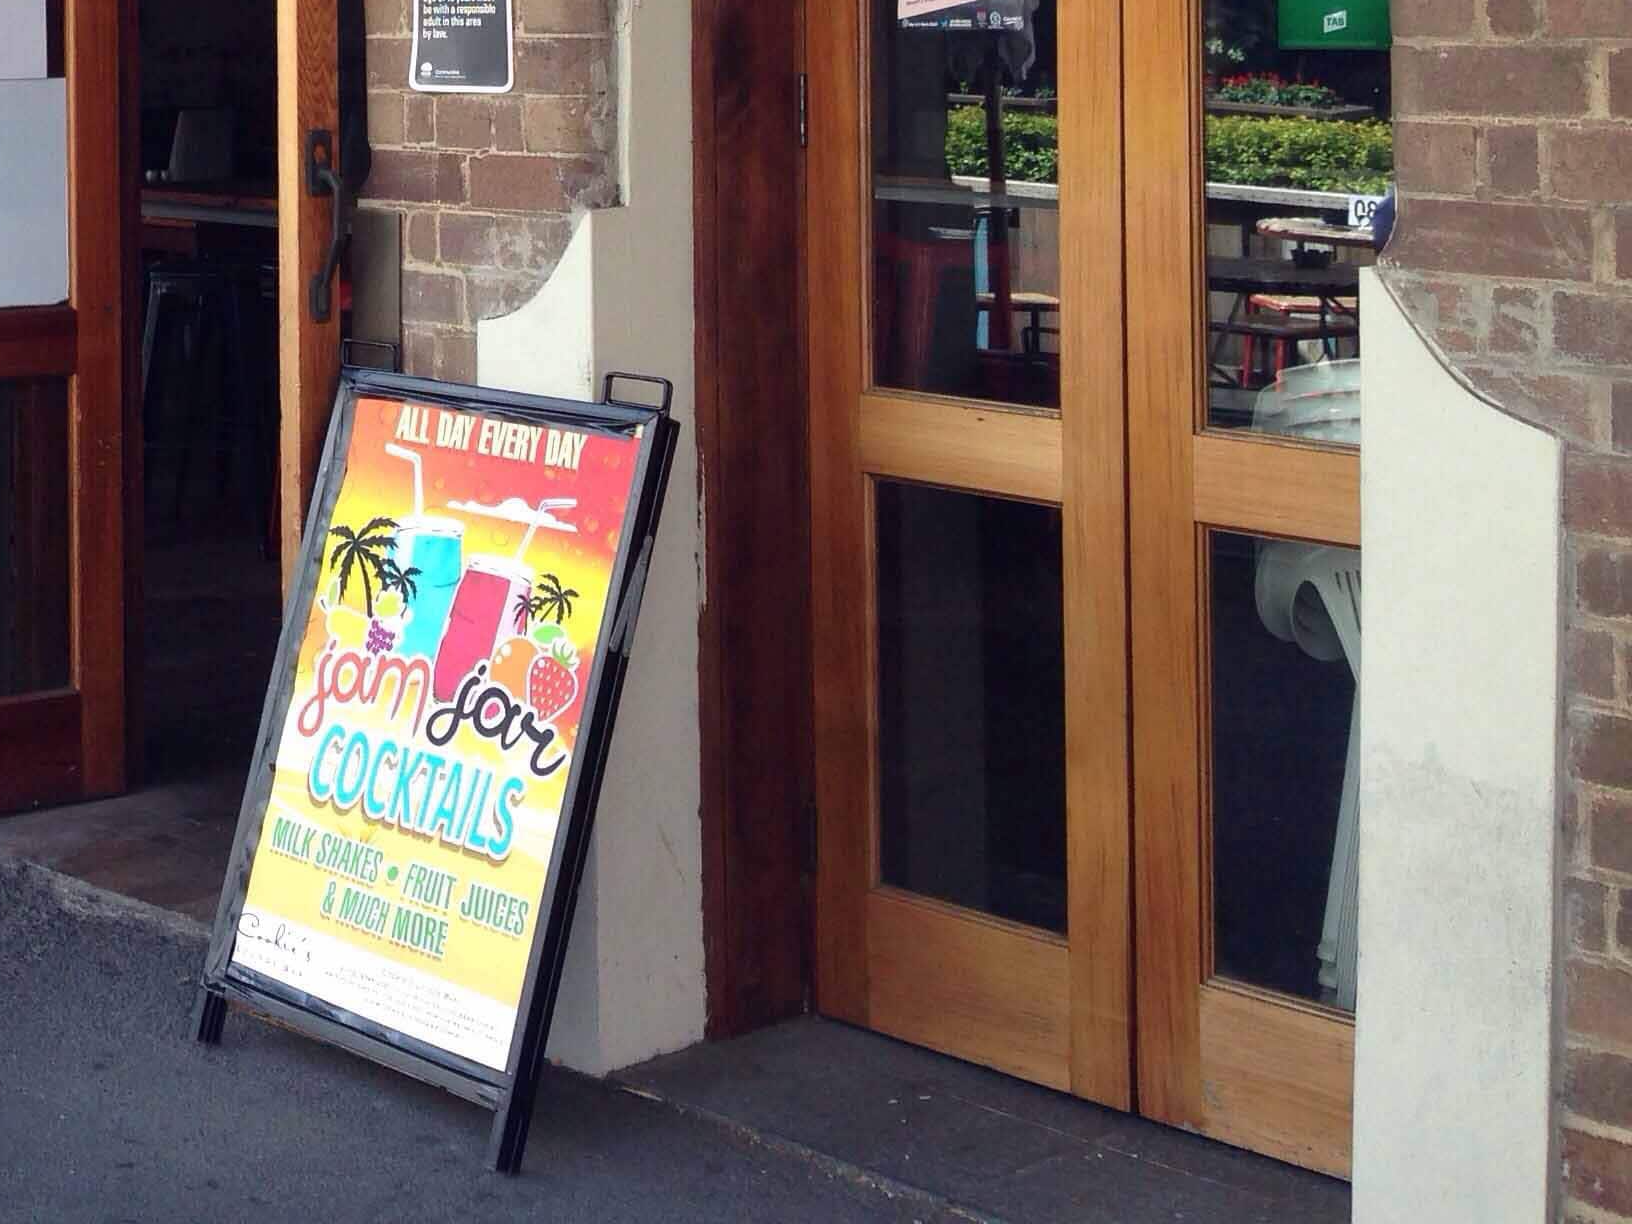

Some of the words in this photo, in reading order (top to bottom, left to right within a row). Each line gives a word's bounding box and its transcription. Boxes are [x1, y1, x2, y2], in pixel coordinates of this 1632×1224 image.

[433, 3, 450, 14] with
[456, 3, 496, 16] responsible
[451, 16, 465, 27] this
[396, 404, 430, 445] ALL
[436, 409, 476, 451] DAY
[478, 417, 544, 464] EVERY
[544, 428, 589, 471] DAY
[296, 638, 430, 739] jam
[425, 664, 569, 777] jar
[308, 723, 525, 856] COCKTAILS
[271, 817, 317, 859] MILK
[316, 832, 384, 883] SHAKES
[402, 863, 457, 910] FRUIT
[460, 883, 529, 936] JUICES
[322, 881, 337, 914] &
[339, 886, 391, 935] MUCH
[391, 905, 449, 955] MORE
